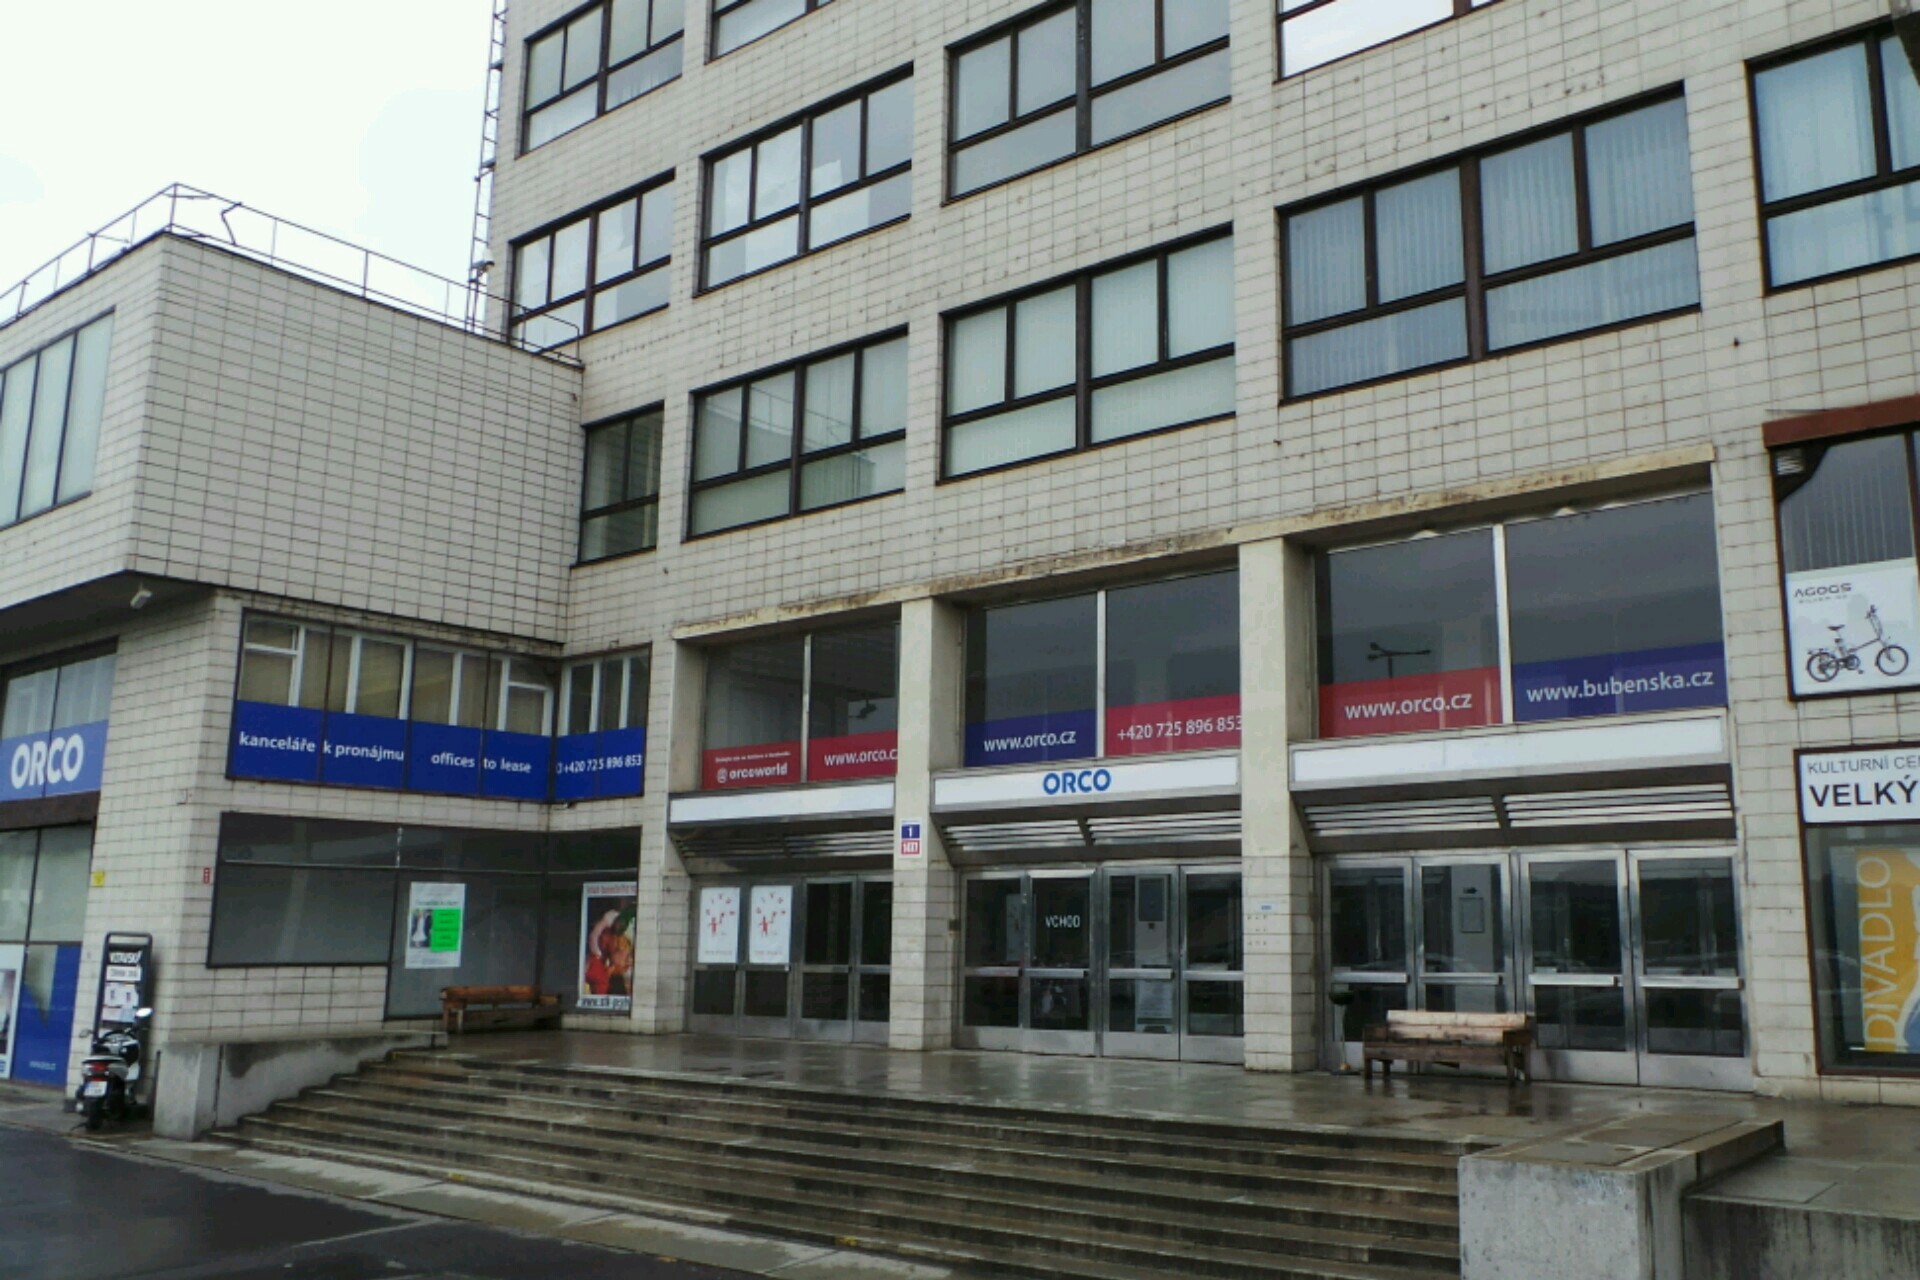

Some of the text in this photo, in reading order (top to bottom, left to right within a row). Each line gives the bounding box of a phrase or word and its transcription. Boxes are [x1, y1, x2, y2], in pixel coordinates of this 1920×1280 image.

[1526, 671, 1714, 702] www.bubenska.cz
[1344, 693, 1473, 720] www.orco.cz
[984, 731, 1077, 752] www.orco.cz
[1117, 723, 1153, 741] +420
[1156, 720, 1183, 738] 725
[1185, 717, 1213, 735] 896
[239, 731, 405, 762] kanceláře k pronájmu
[11, 733, 84, 790] ORCO
[431, 751, 532, 774] offices to lease
[564, 753, 642, 774] +420 725 896 853
[1807, 754, 1920, 774] KULTURNÍ CE
[1043, 768, 1112, 795] ORCO
[1808, 774, 1919, 808] VELKÝ
[1045, 914, 1081, 929] VCHOD
[1856, 856, 1898, 1043] DIVADLO
